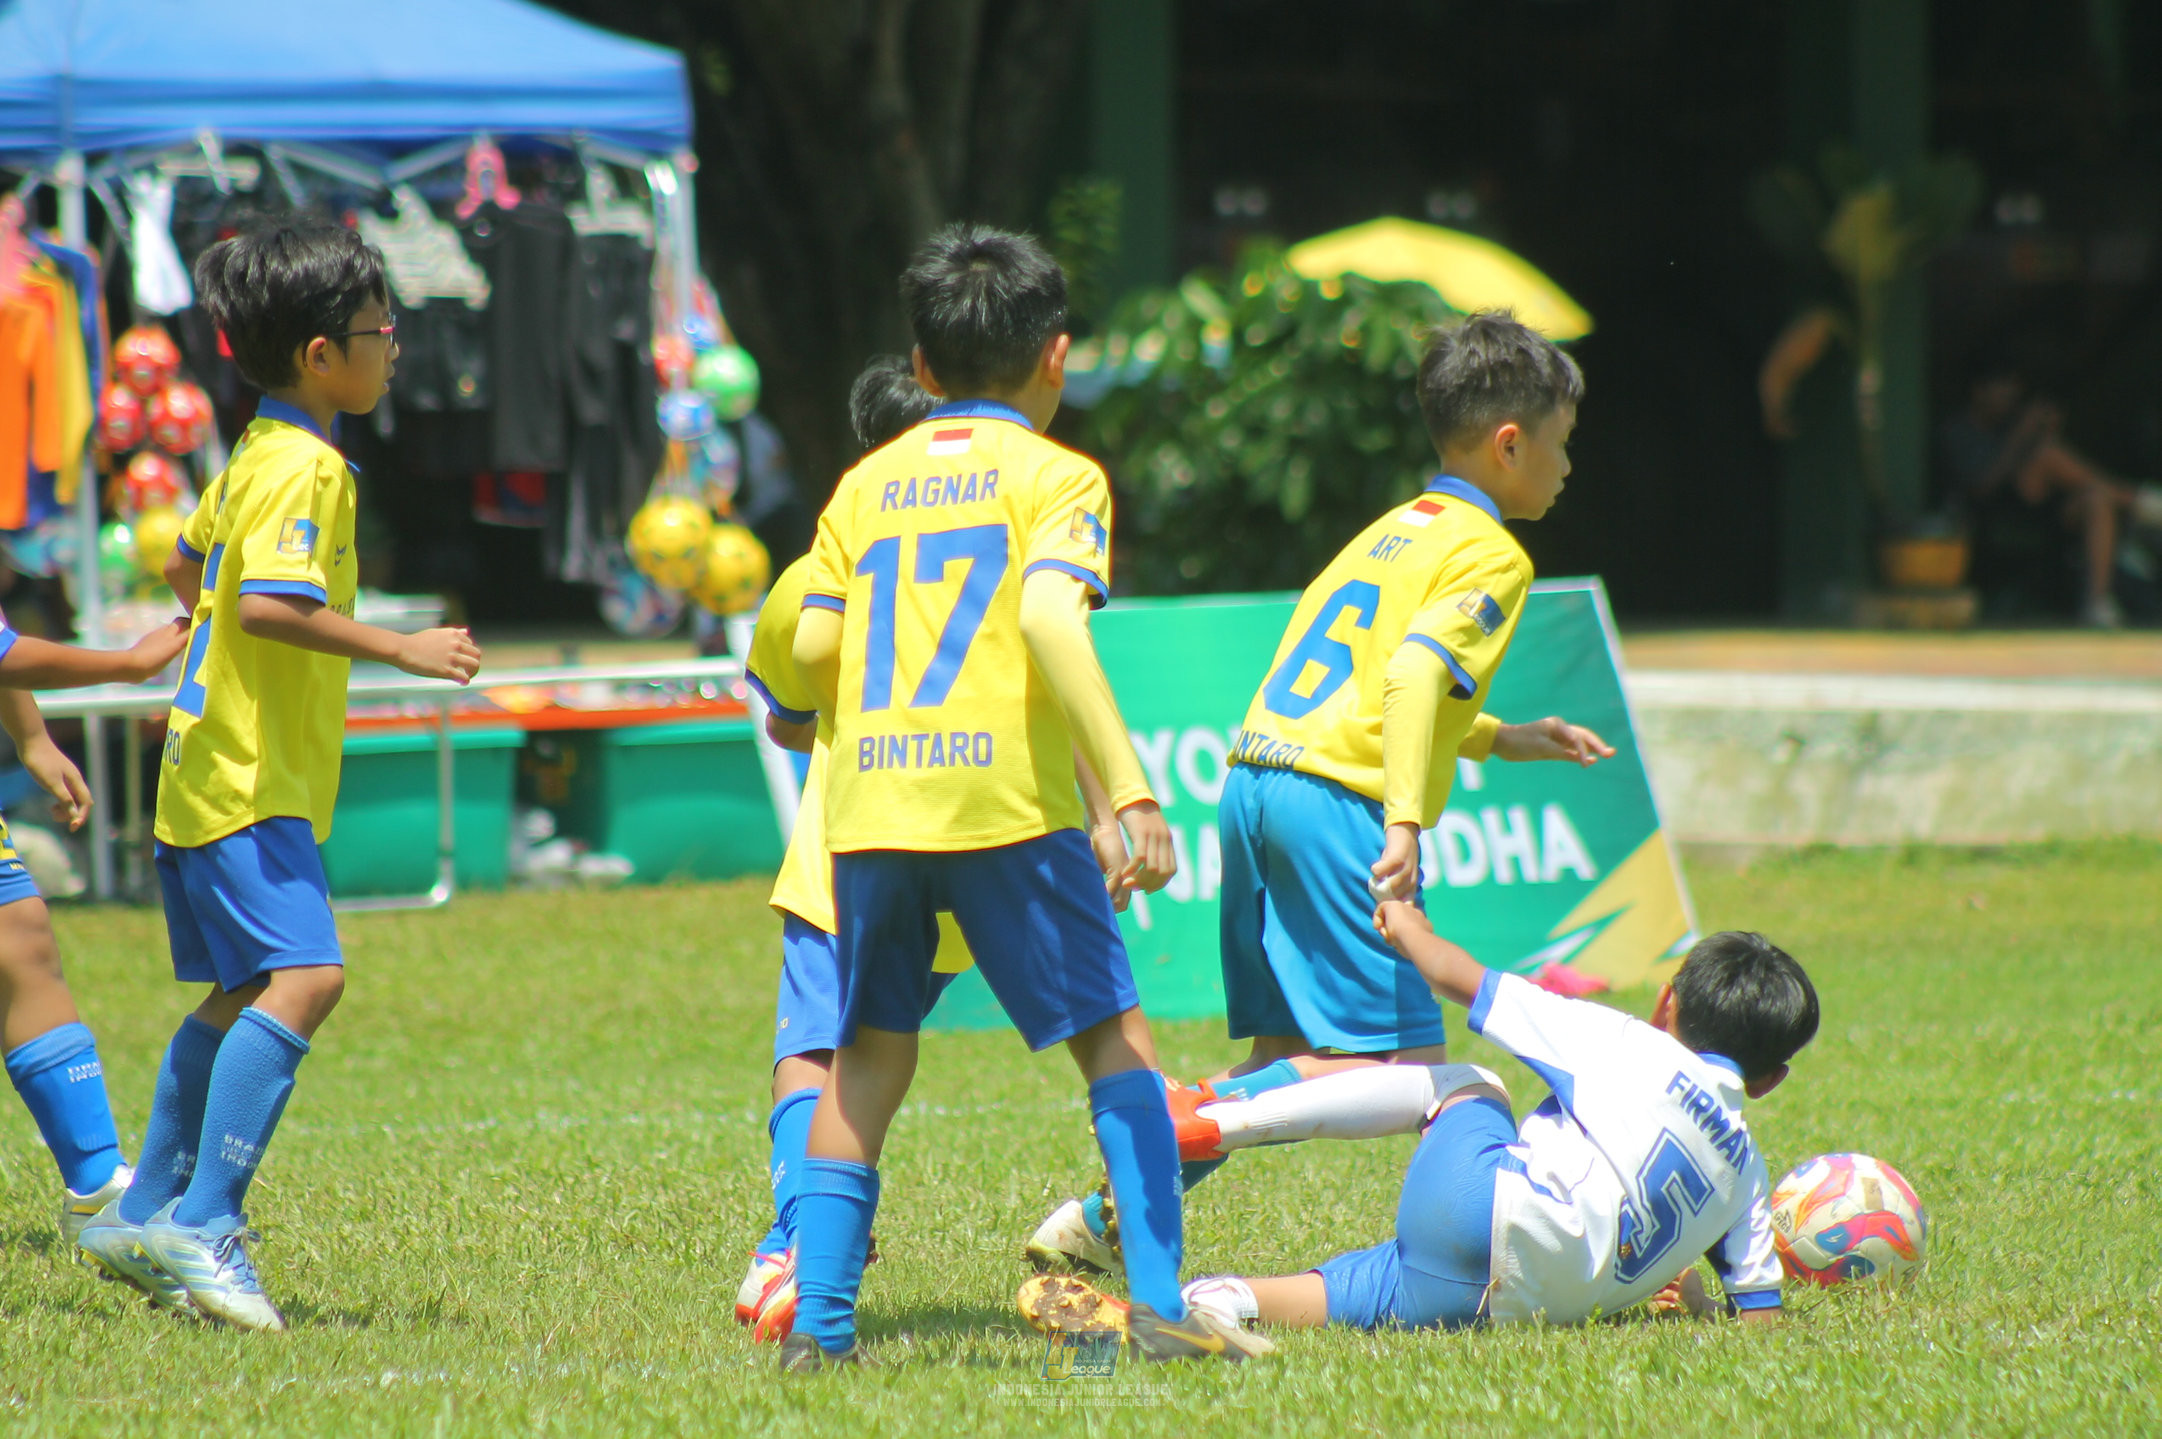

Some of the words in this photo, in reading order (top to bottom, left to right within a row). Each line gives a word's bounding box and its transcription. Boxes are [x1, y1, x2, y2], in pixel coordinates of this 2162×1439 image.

[881, 469, 998, 512] RAGNAR
[1368, 534, 1413, 562] ART
[855, 524, 1008, 713] 17
[1263, 579, 1380, 720] 6
[858, 731, 993, 773] BINTARO
[1233, 730, 1304, 770] INTARO
[1614, 1126, 1715, 1284] 5
